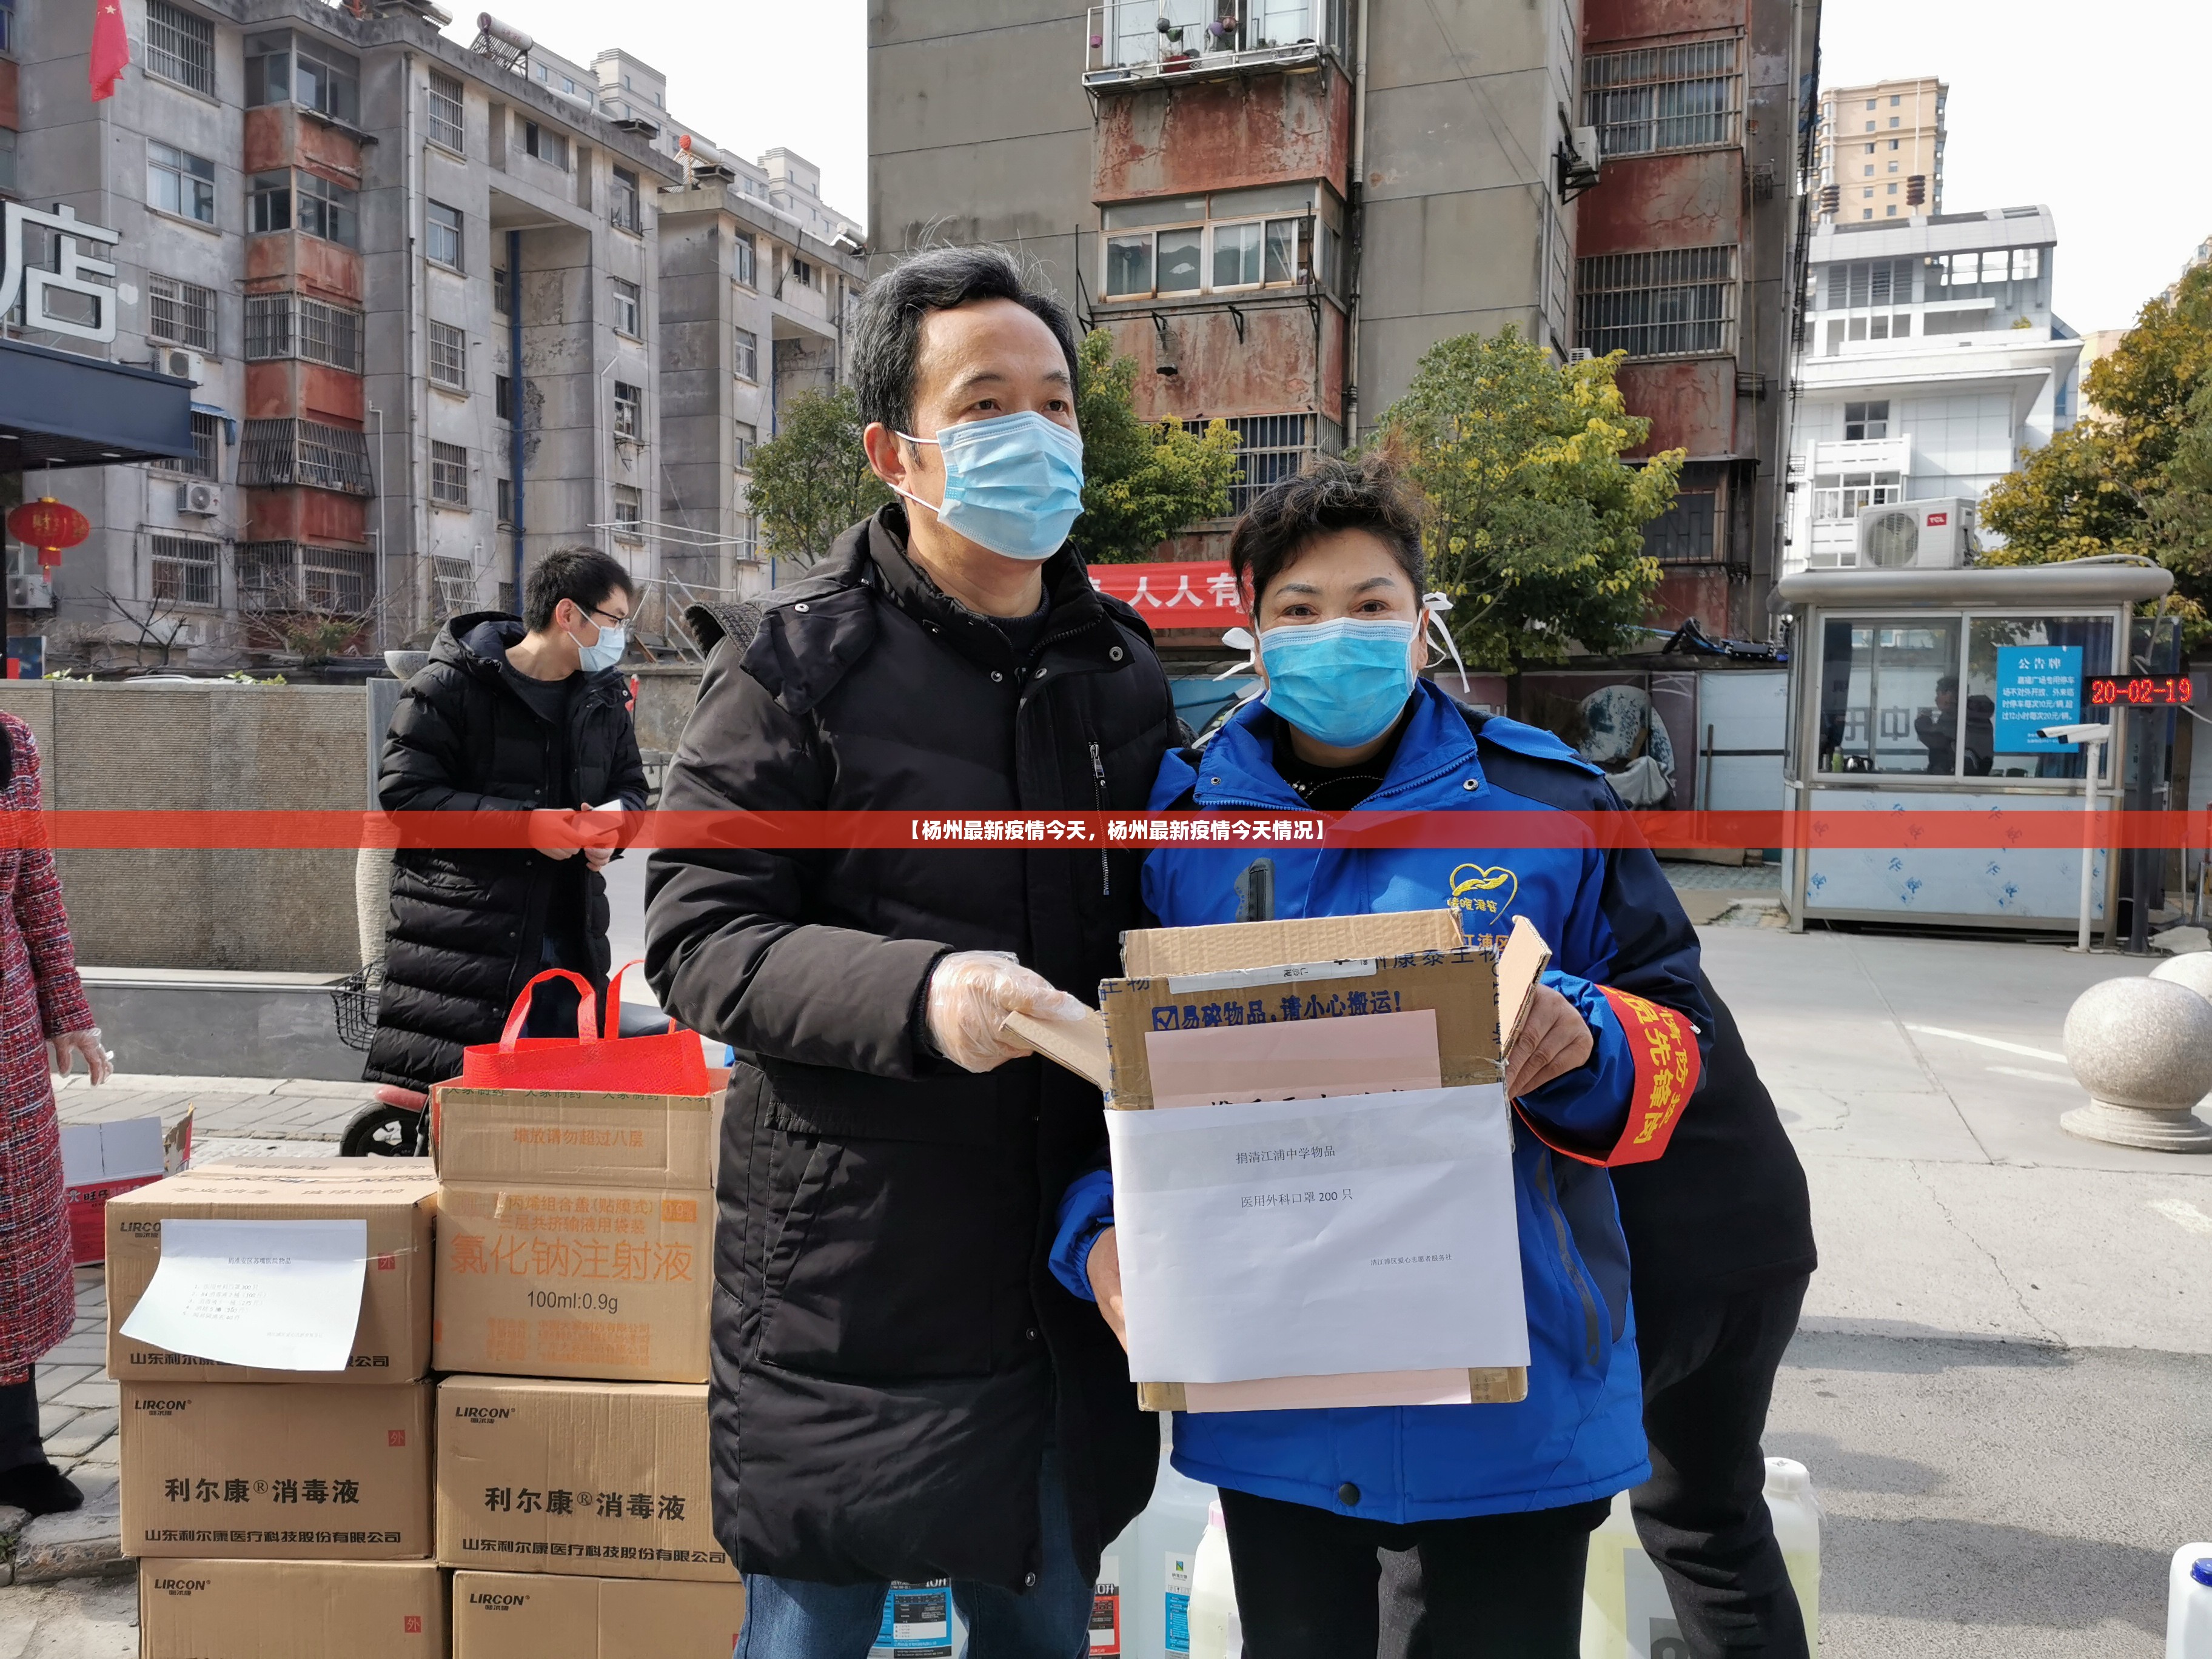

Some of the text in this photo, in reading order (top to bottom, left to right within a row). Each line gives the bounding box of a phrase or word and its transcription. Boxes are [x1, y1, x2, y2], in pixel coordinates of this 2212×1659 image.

[0, 201, 119, 344] 店
[2018, 657, 2061, 669] 公告牌
[2093, 678, 2192, 703] 20-02-19
[1610, 990, 1674, 1144] 员先锋岗
[514, 1128, 644, 1148] 堆放请勿超过八层
[1236, 1145, 1336, 1165] 捐清江浦中学物品
[498, 1193, 654, 1216] 丙烯组合盖(贴膜式)
[1241, 1188, 1353, 1208] 医用外科口罩 200 只
[119, 1222, 161, 1232] LIRCO
[451, 1232, 693, 1282] 氯化钠注射液
[1370, 1253, 1453, 1267] 清江浦区爱心志愿者服务社
[528, 1291, 618, 1315] 100ml:0.9g
[390, 1431, 403, 1444] 外
[144, 1529, 401, 1544] 山东利尔康医疗科技股份有限公司
[462, 1538, 727, 1564] 山东利尔康医疗科技股份有限公司
[406, 1618, 420, 1631] 外
